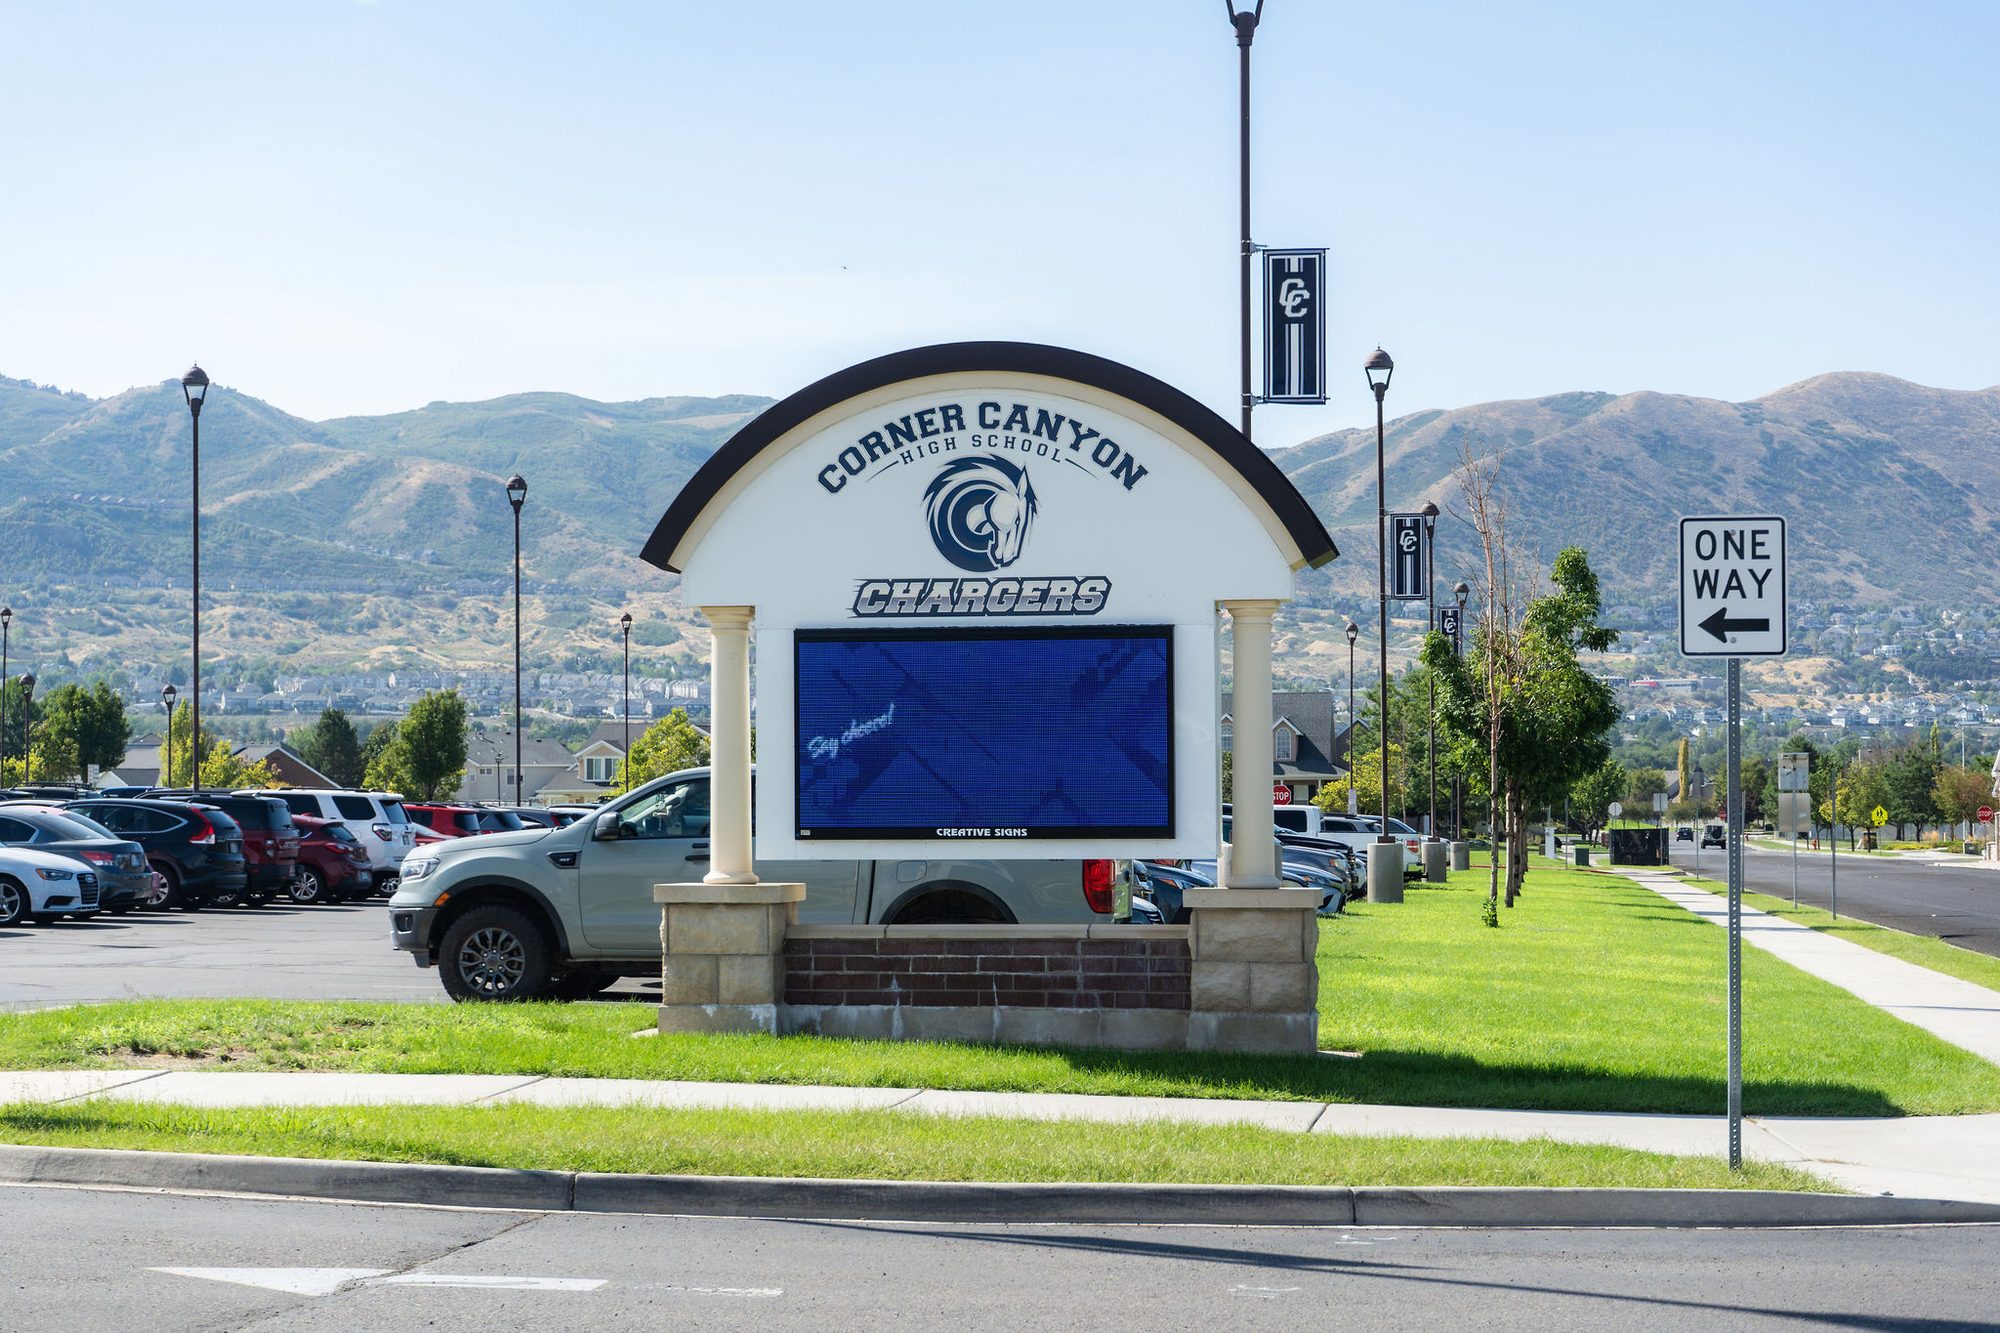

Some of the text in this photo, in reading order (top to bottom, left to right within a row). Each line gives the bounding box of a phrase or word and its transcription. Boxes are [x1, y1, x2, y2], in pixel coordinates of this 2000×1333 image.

[817, 401, 1150, 494] CORNER CANYON
[901, 434, 1062, 465] HIGH SCHOOL
[1695, 529, 1770, 560] ONE
[851, 576, 1112, 617] CHARGERS
[1693, 568, 1772, 599] WAY
[936, 828, 1028, 837] CREATIVE SIGNS
